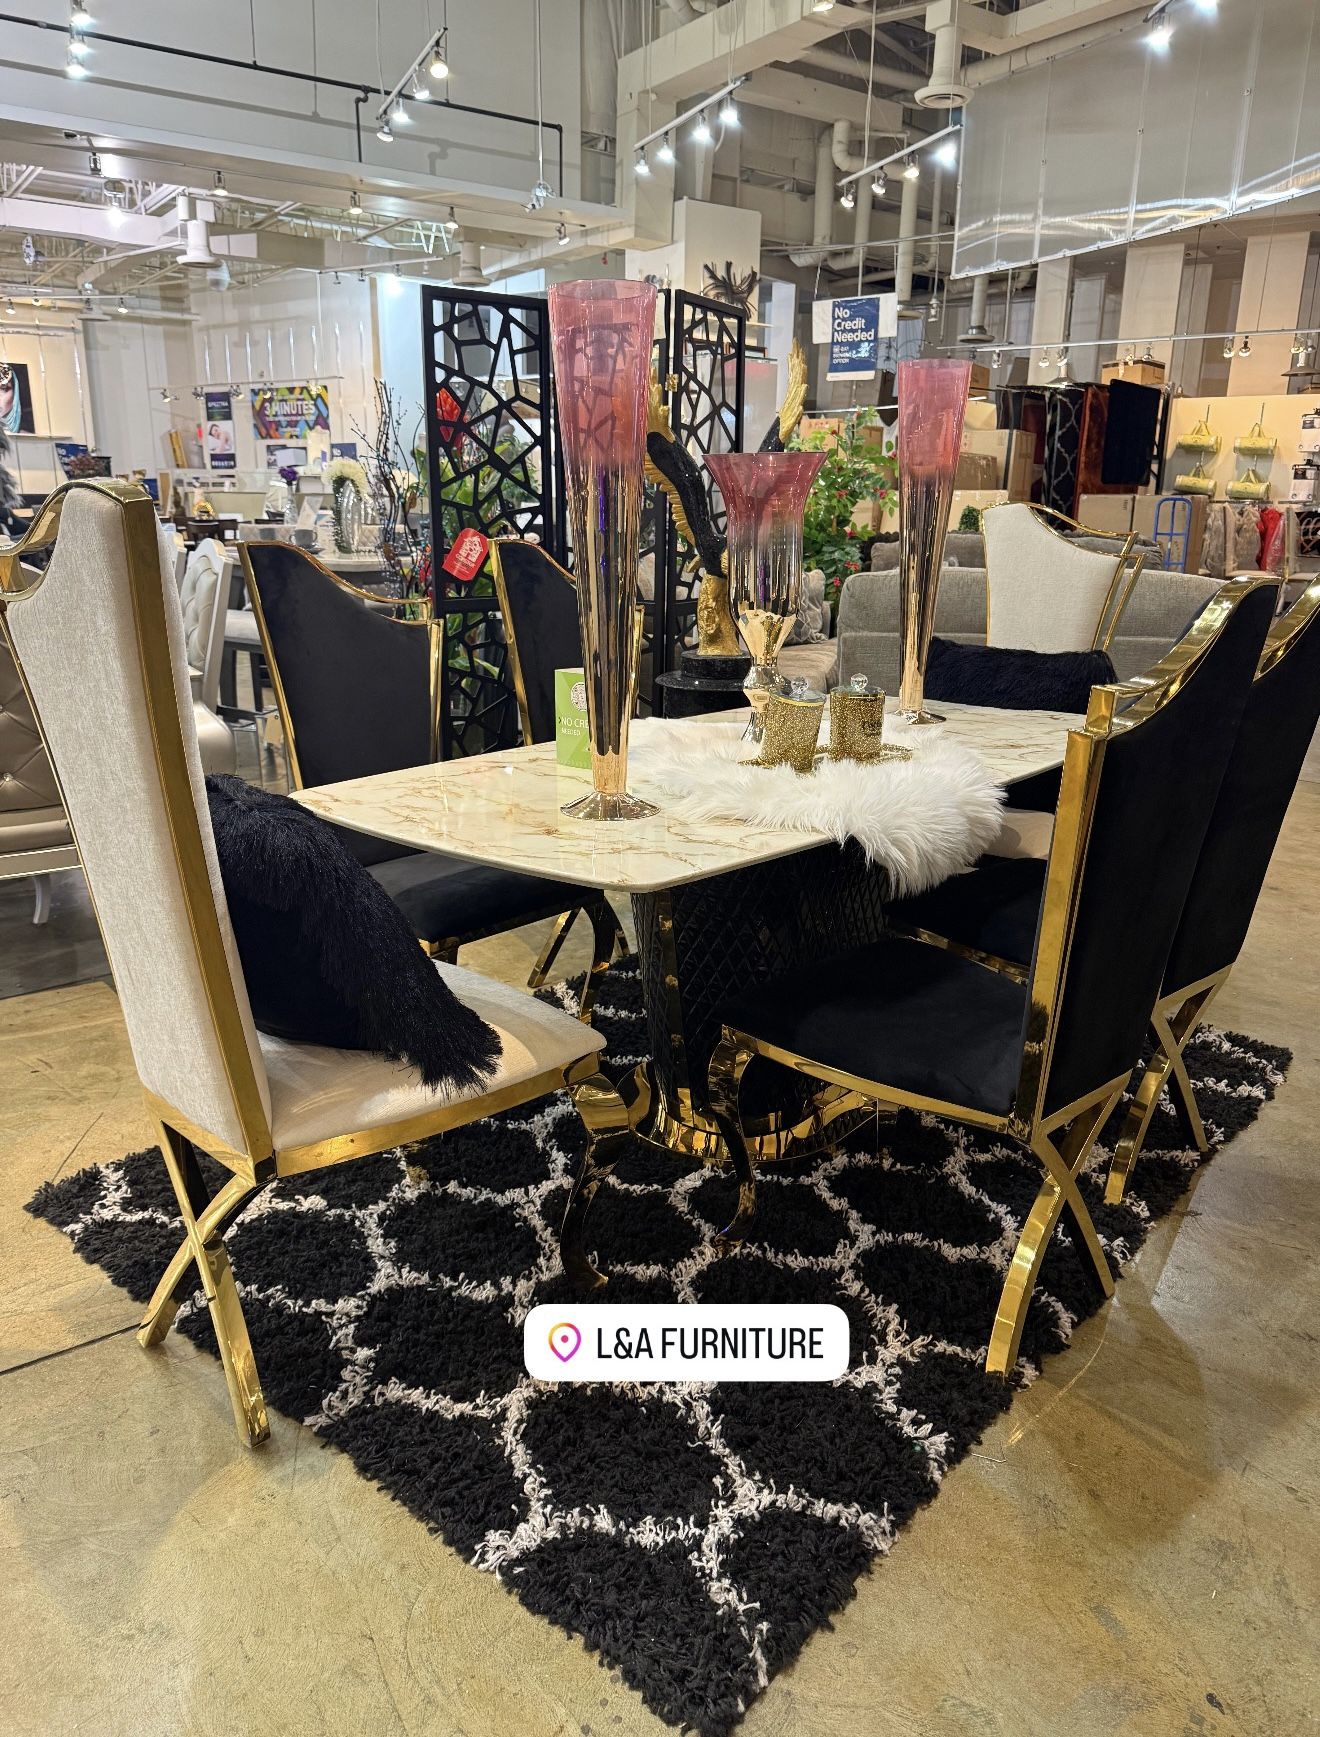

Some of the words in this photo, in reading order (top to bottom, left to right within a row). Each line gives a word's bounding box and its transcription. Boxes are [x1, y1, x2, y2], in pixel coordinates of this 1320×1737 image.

[834, 307, 850, 318] No
[834, 318, 866, 331] Credit
[833, 329, 875, 342] Needed
[264, 402, 271, 415] 3
[271, 400, 315, 415] MINUTES
[561, 717, 573, 726] NO
[574, 718, 589, 728] CRE
[561, 728, 581, 736] NEEDED
